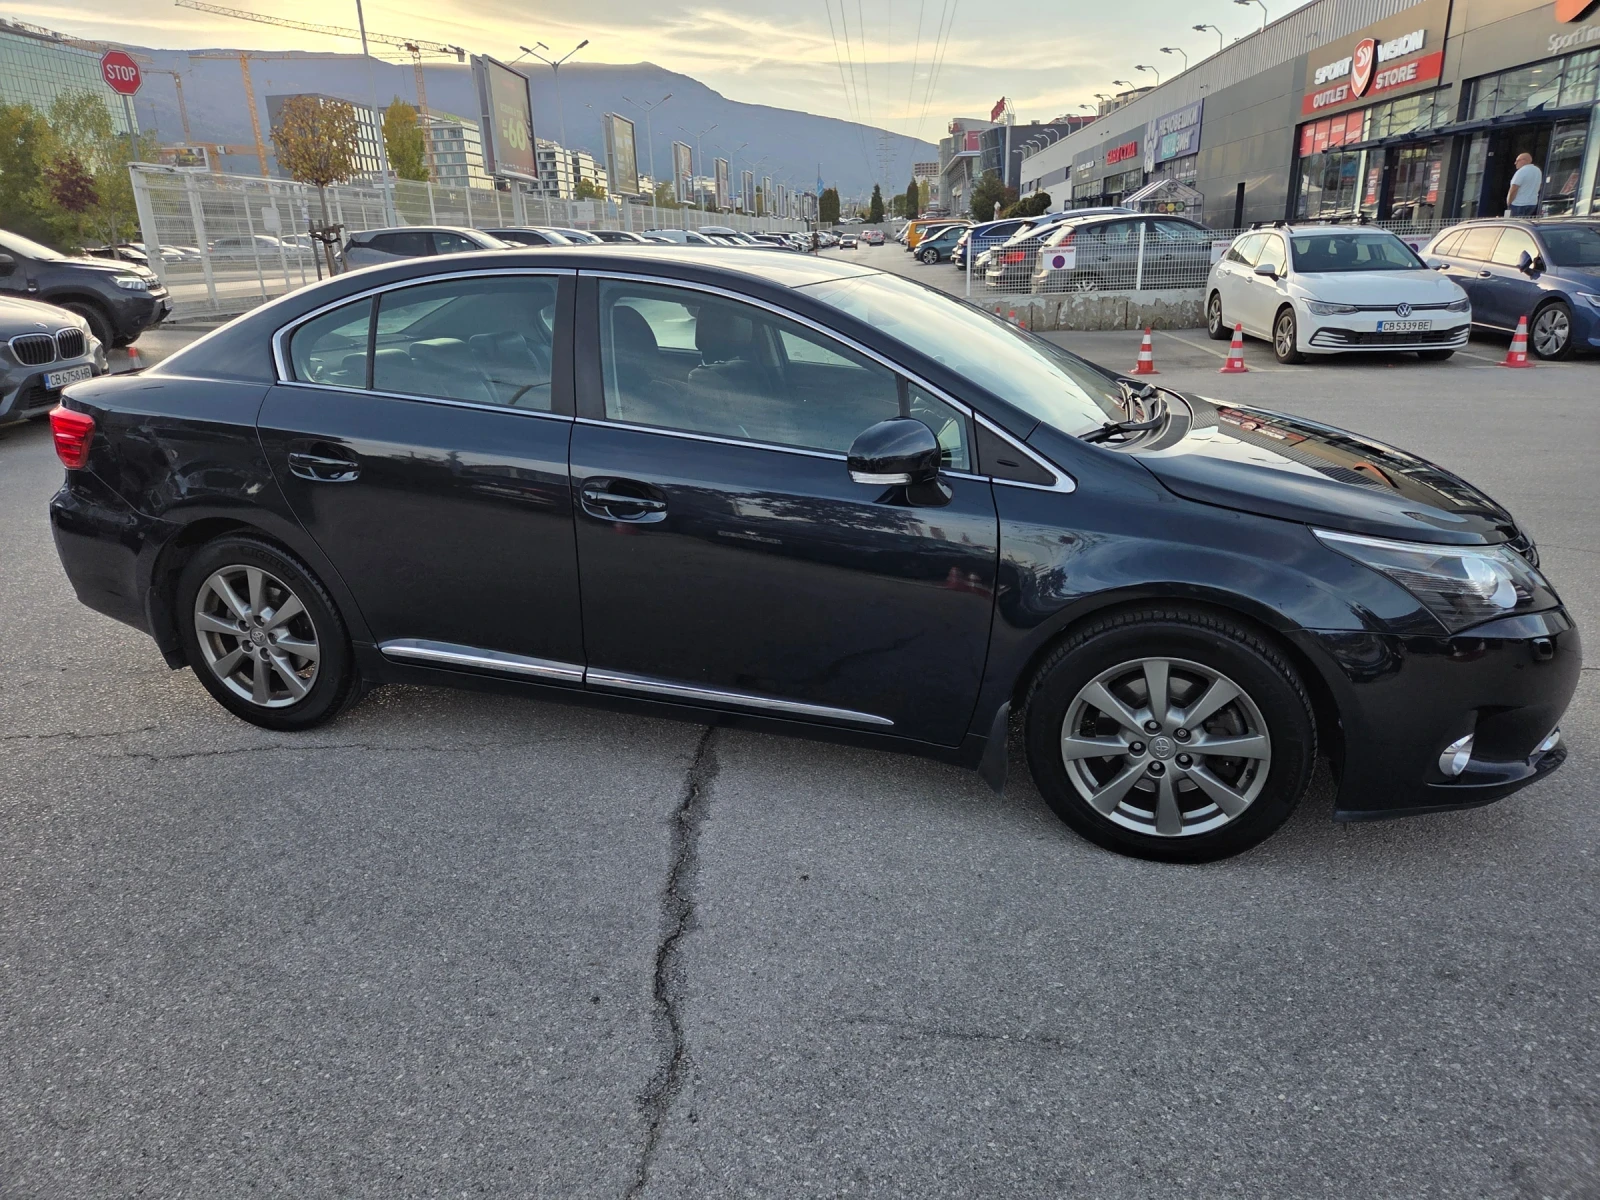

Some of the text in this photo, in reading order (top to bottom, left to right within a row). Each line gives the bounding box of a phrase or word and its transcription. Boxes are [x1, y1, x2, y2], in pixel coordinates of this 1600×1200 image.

[1314, 29, 1425, 85] SPORT VISION
[106, 64, 136, 81] STOP
[1313, 62, 1417, 109] OUTLET STORE
[1383, 321, 1429, 331] CB 5339 BE
[50, 374, 62, 386] CB
[62, 370, 80, 384] 6758
